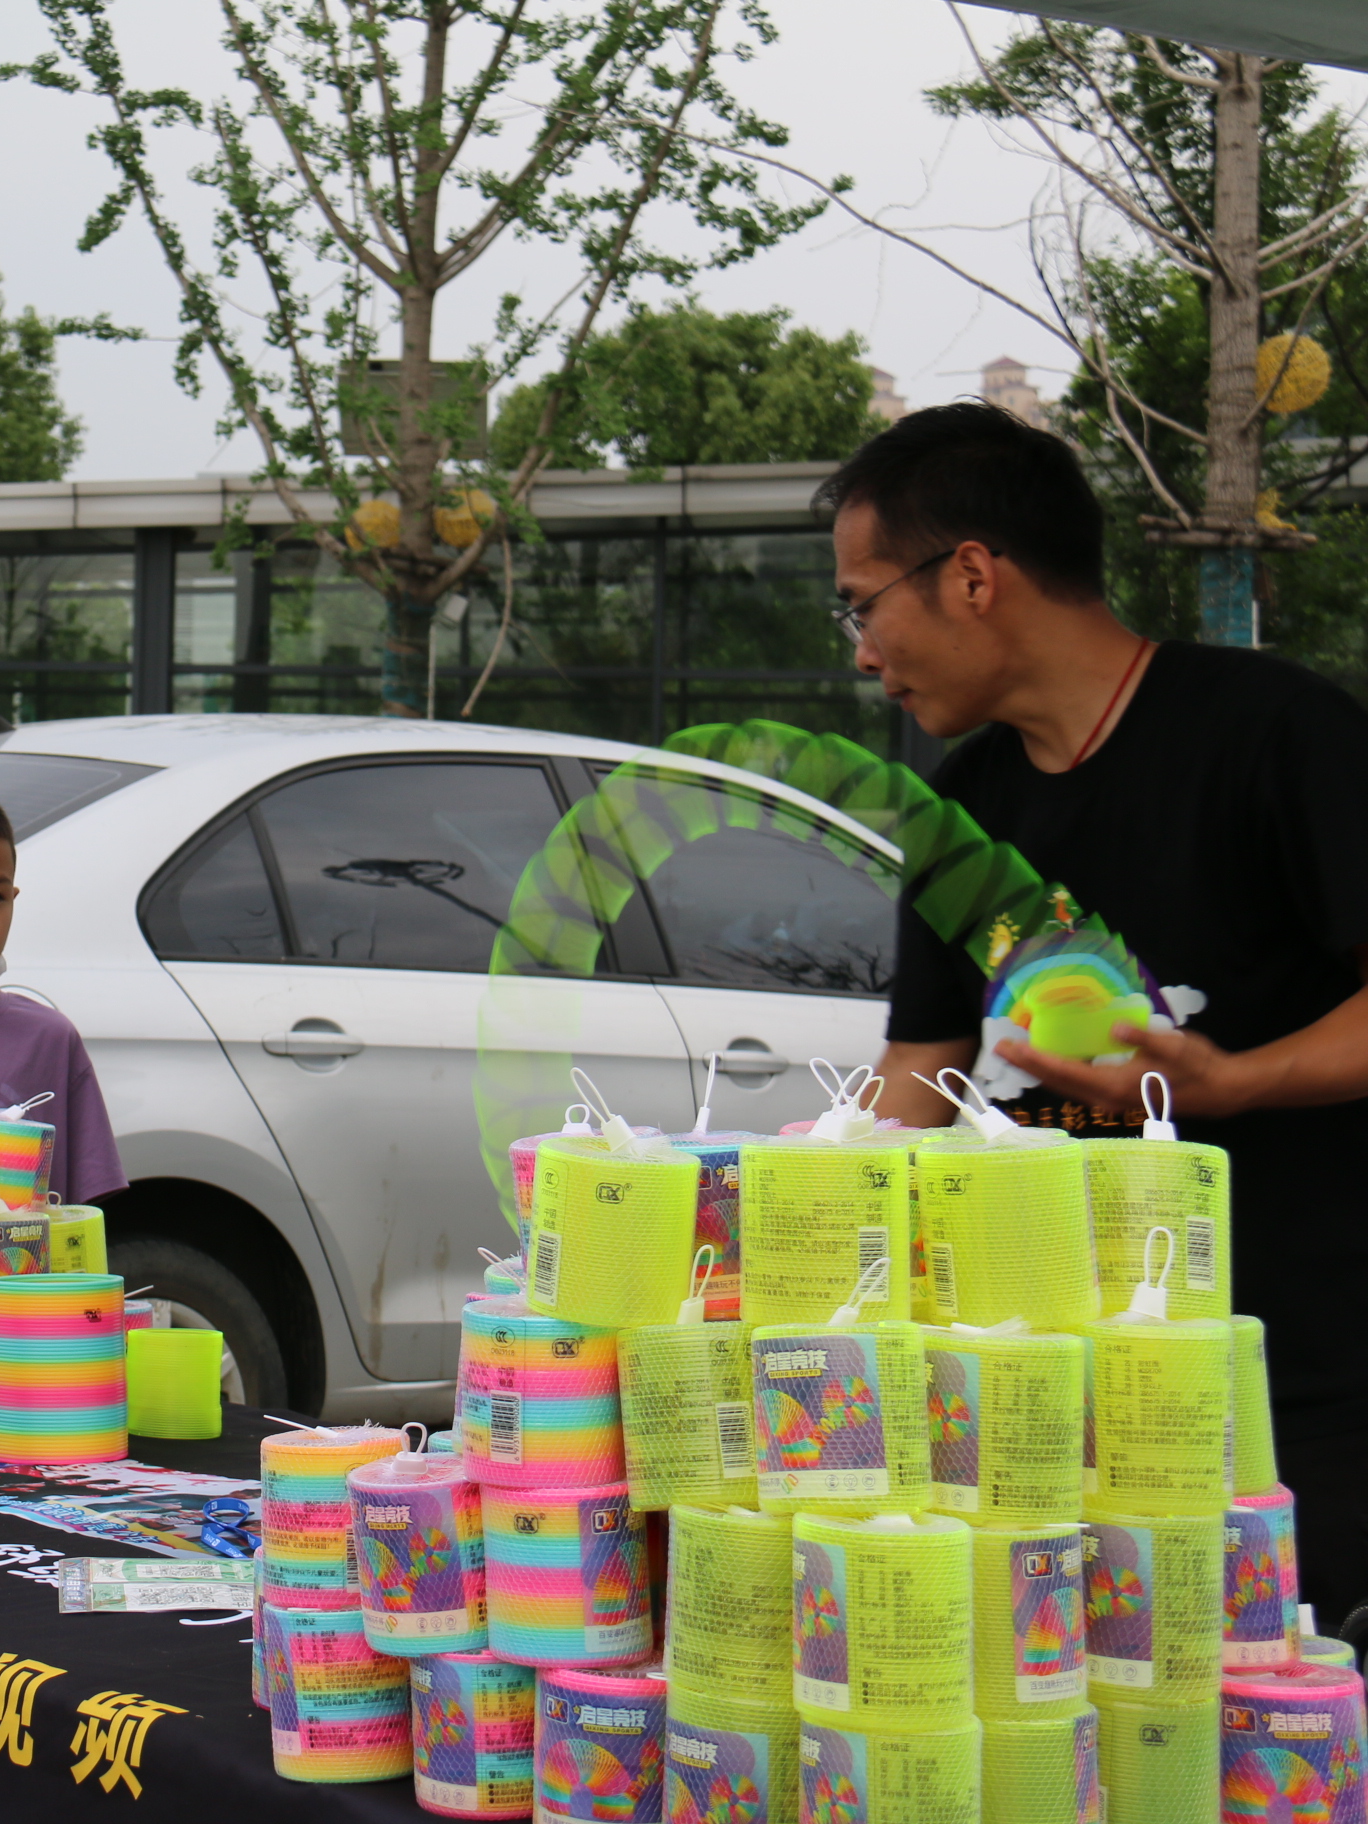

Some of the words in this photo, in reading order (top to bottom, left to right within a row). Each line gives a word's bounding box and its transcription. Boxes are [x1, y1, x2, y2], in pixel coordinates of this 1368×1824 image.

[764, 1350, 829, 1372] 启星竞技
[365, 1505, 413, 1523] 启星竞技
[1025, 1554, 1052, 1577] QX
[576, 1704, 647, 1728] 启星竞技
[1268, 1711, 1333, 1733] 启星竞技
